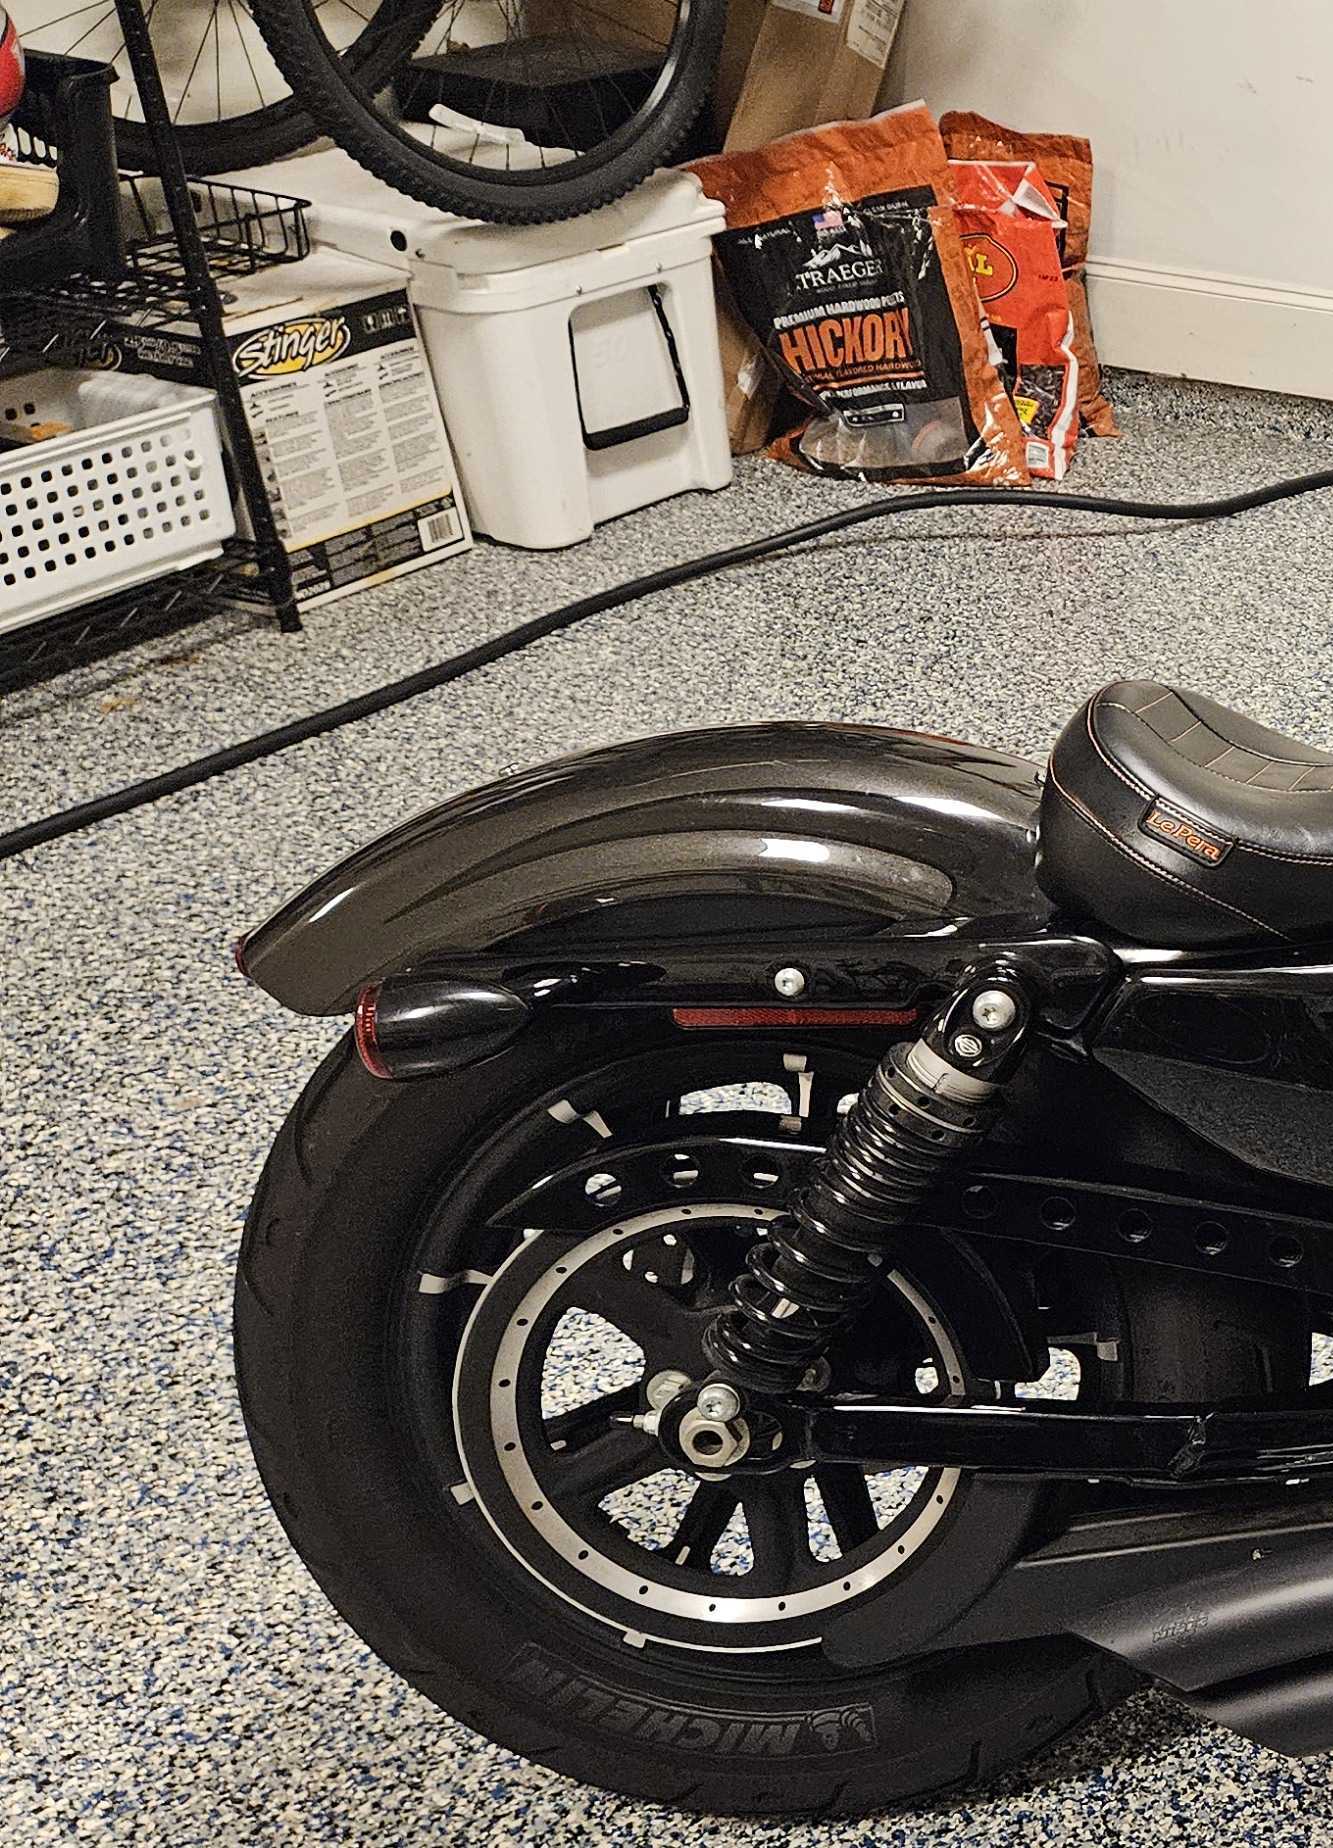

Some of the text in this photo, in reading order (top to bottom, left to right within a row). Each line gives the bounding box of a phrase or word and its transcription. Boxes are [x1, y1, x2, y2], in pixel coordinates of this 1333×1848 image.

[796, 258, 884, 291] TRAEGER
[773, 306, 827, 330] PREMIUM
[778, 306, 913, 374] HICKORY
[237, 316, 346, 377] Stinger
[1173, 824, 1220, 861] Pera
[508, 1658, 801, 1755] MICHELIN
